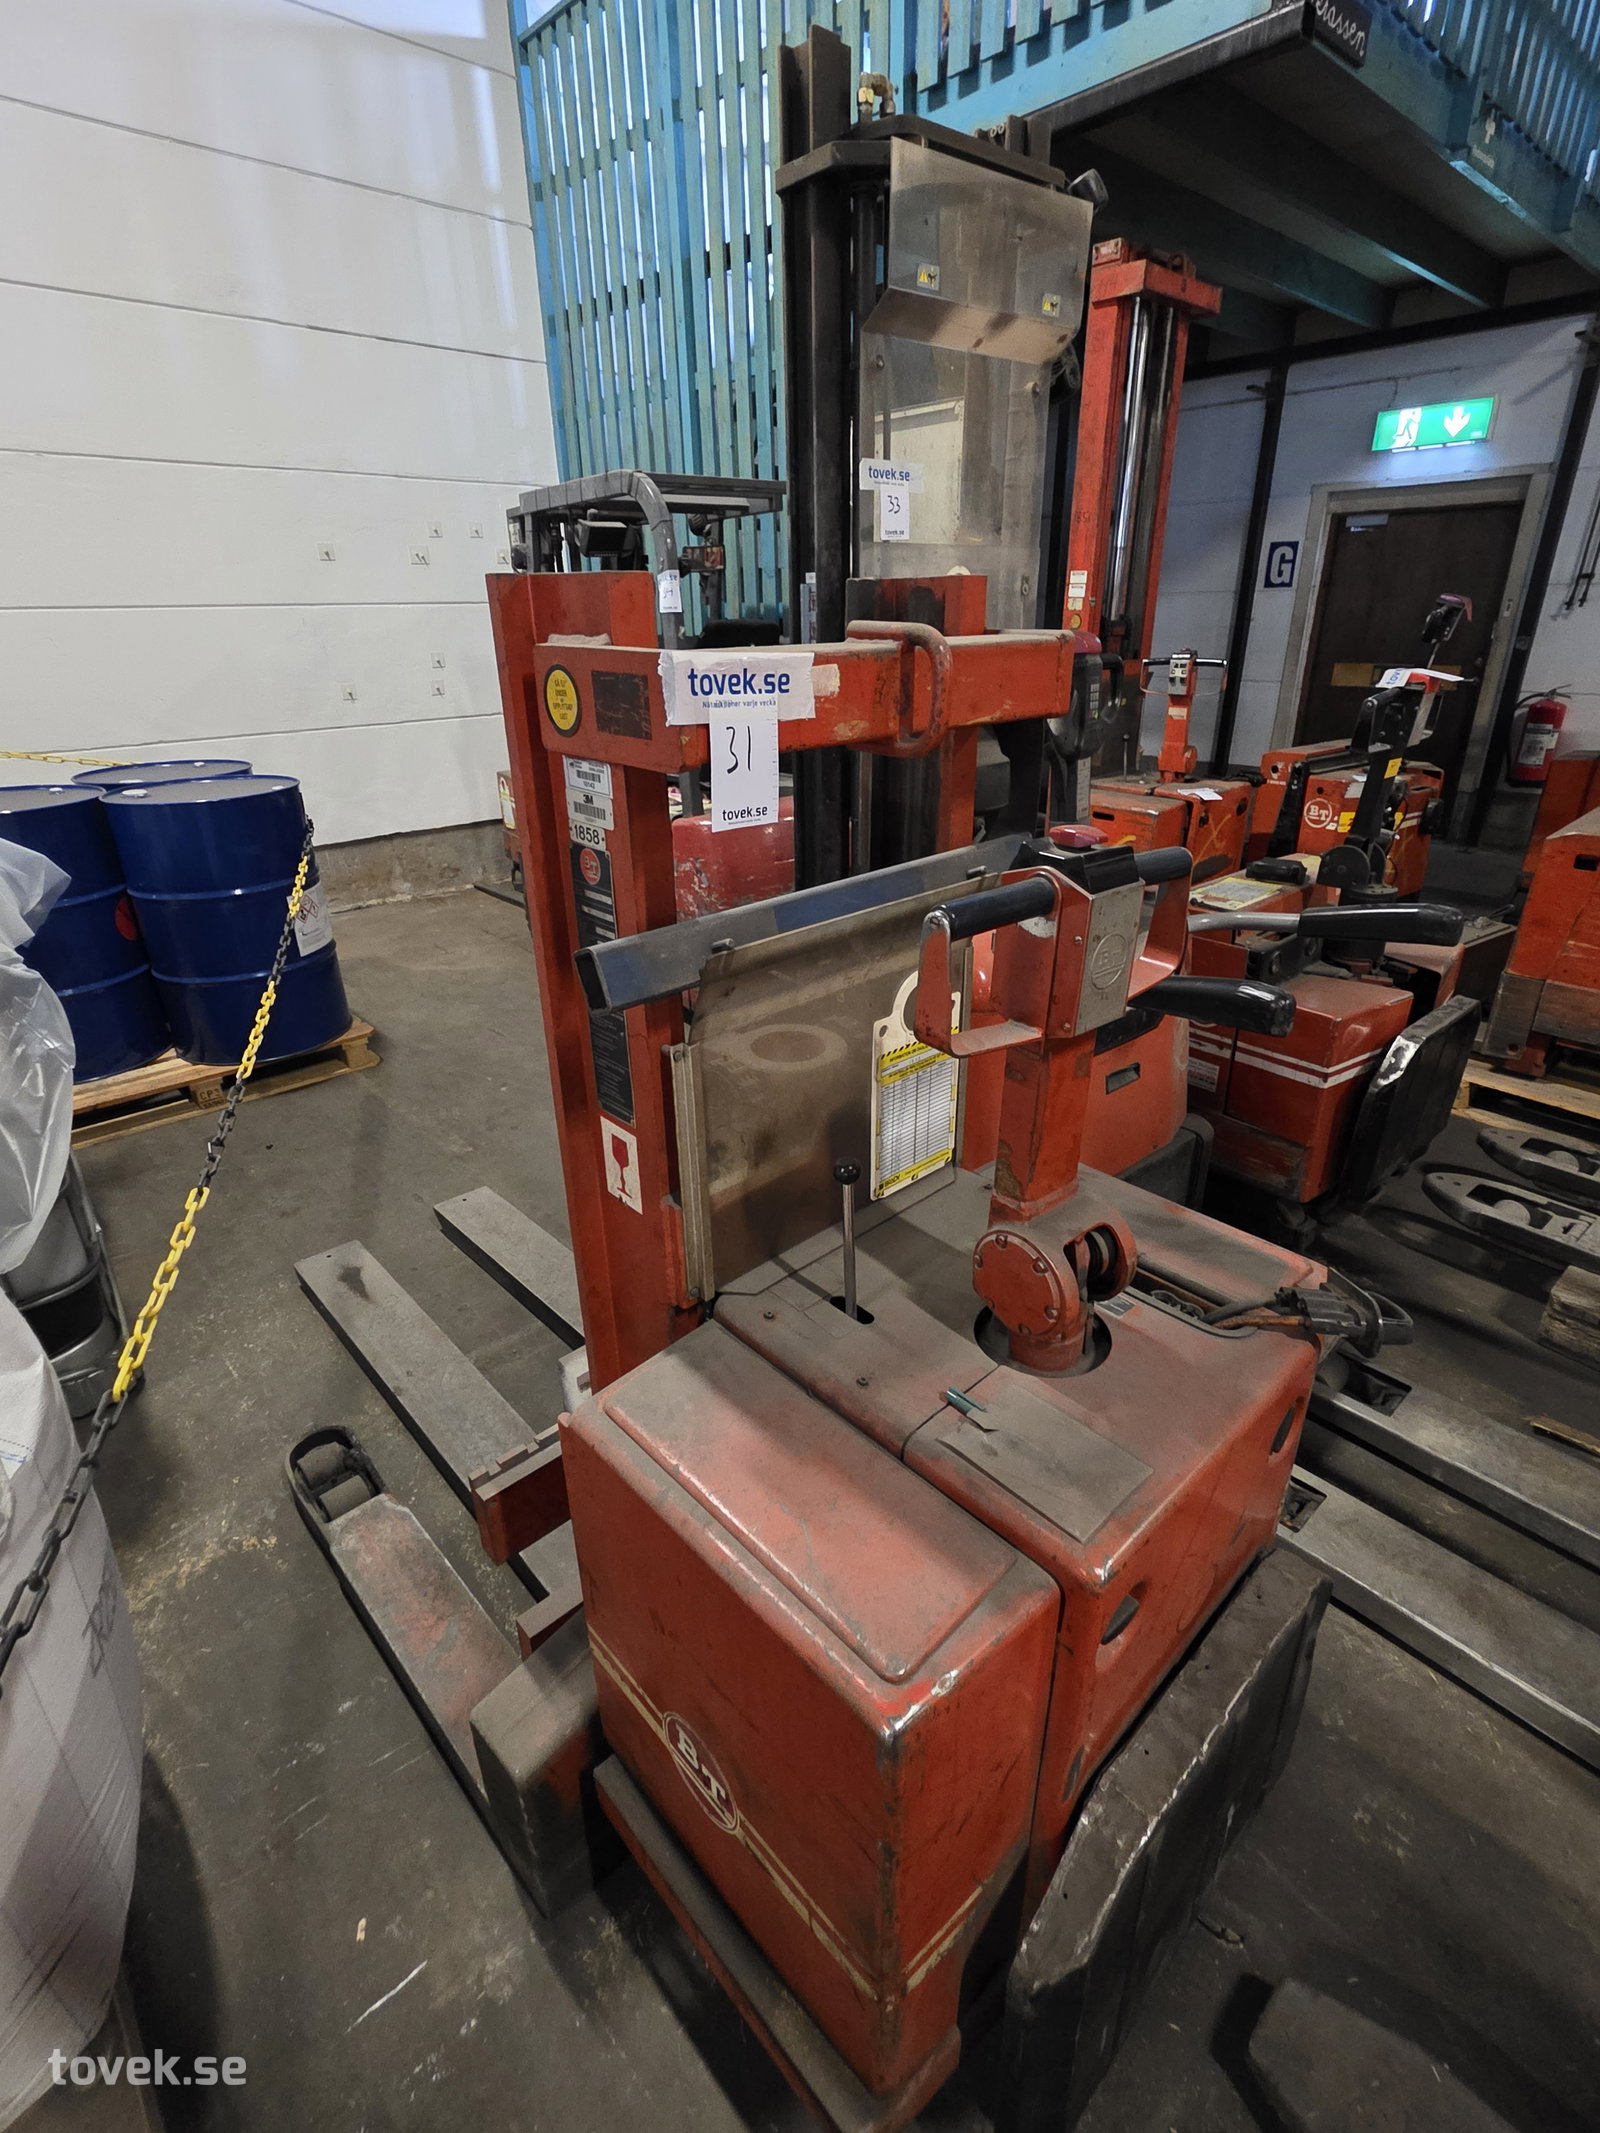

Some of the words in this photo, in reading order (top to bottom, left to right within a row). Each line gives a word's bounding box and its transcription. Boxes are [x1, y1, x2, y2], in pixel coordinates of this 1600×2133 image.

[868, 465, 910, 481] tovek.se
[887, 495, 901, 514] 33
[1269, 545, 1294, 585] G
[688, 668, 790, 696] tovek.se
[726, 725, 752, 774] 31
[583, 794, 594, 805] 3M
[722, 806, 768, 822] tovek.se
[1309, 804, 1329, 821] BT
[574, 824, 600, 845] 1858
[675, 1722, 727, 1802] BT
